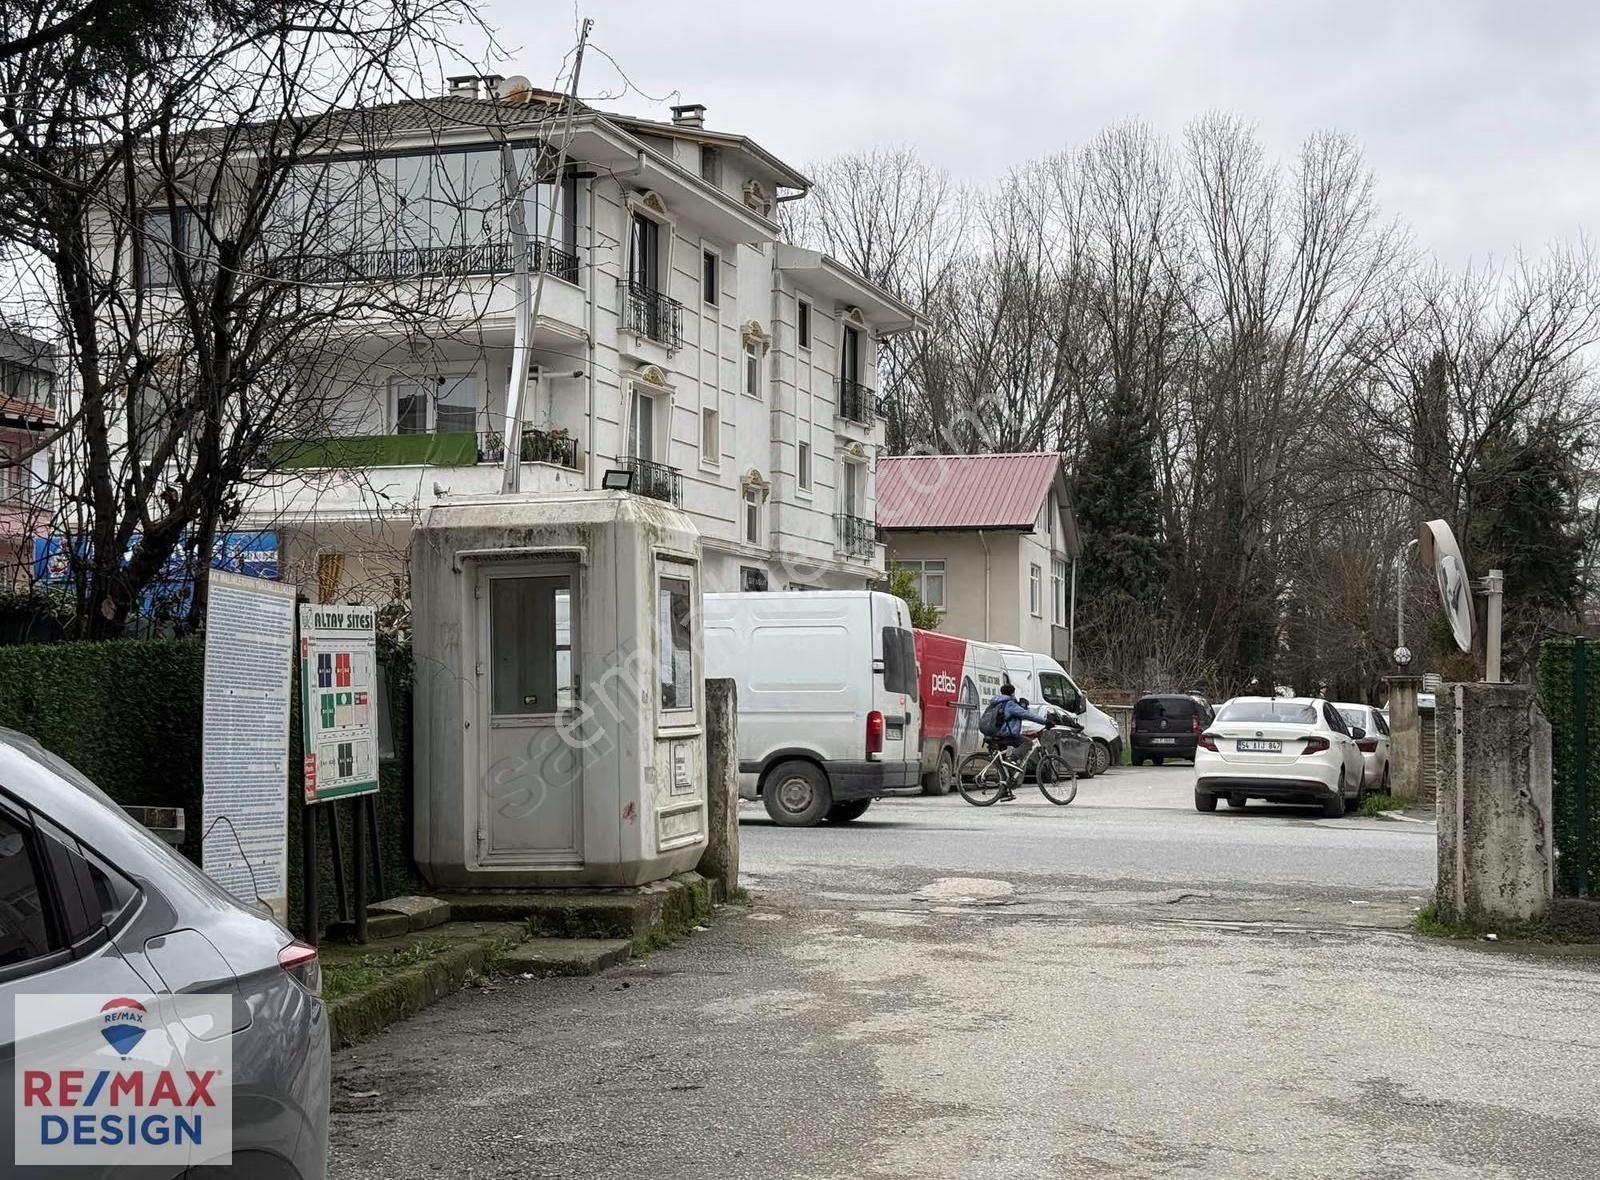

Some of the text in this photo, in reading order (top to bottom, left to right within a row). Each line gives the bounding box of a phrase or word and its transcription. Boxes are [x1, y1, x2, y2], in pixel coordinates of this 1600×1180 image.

[314, 610, 374, 629] ALTAY SİTESİ
[931, 670, 956, 696] petlas
